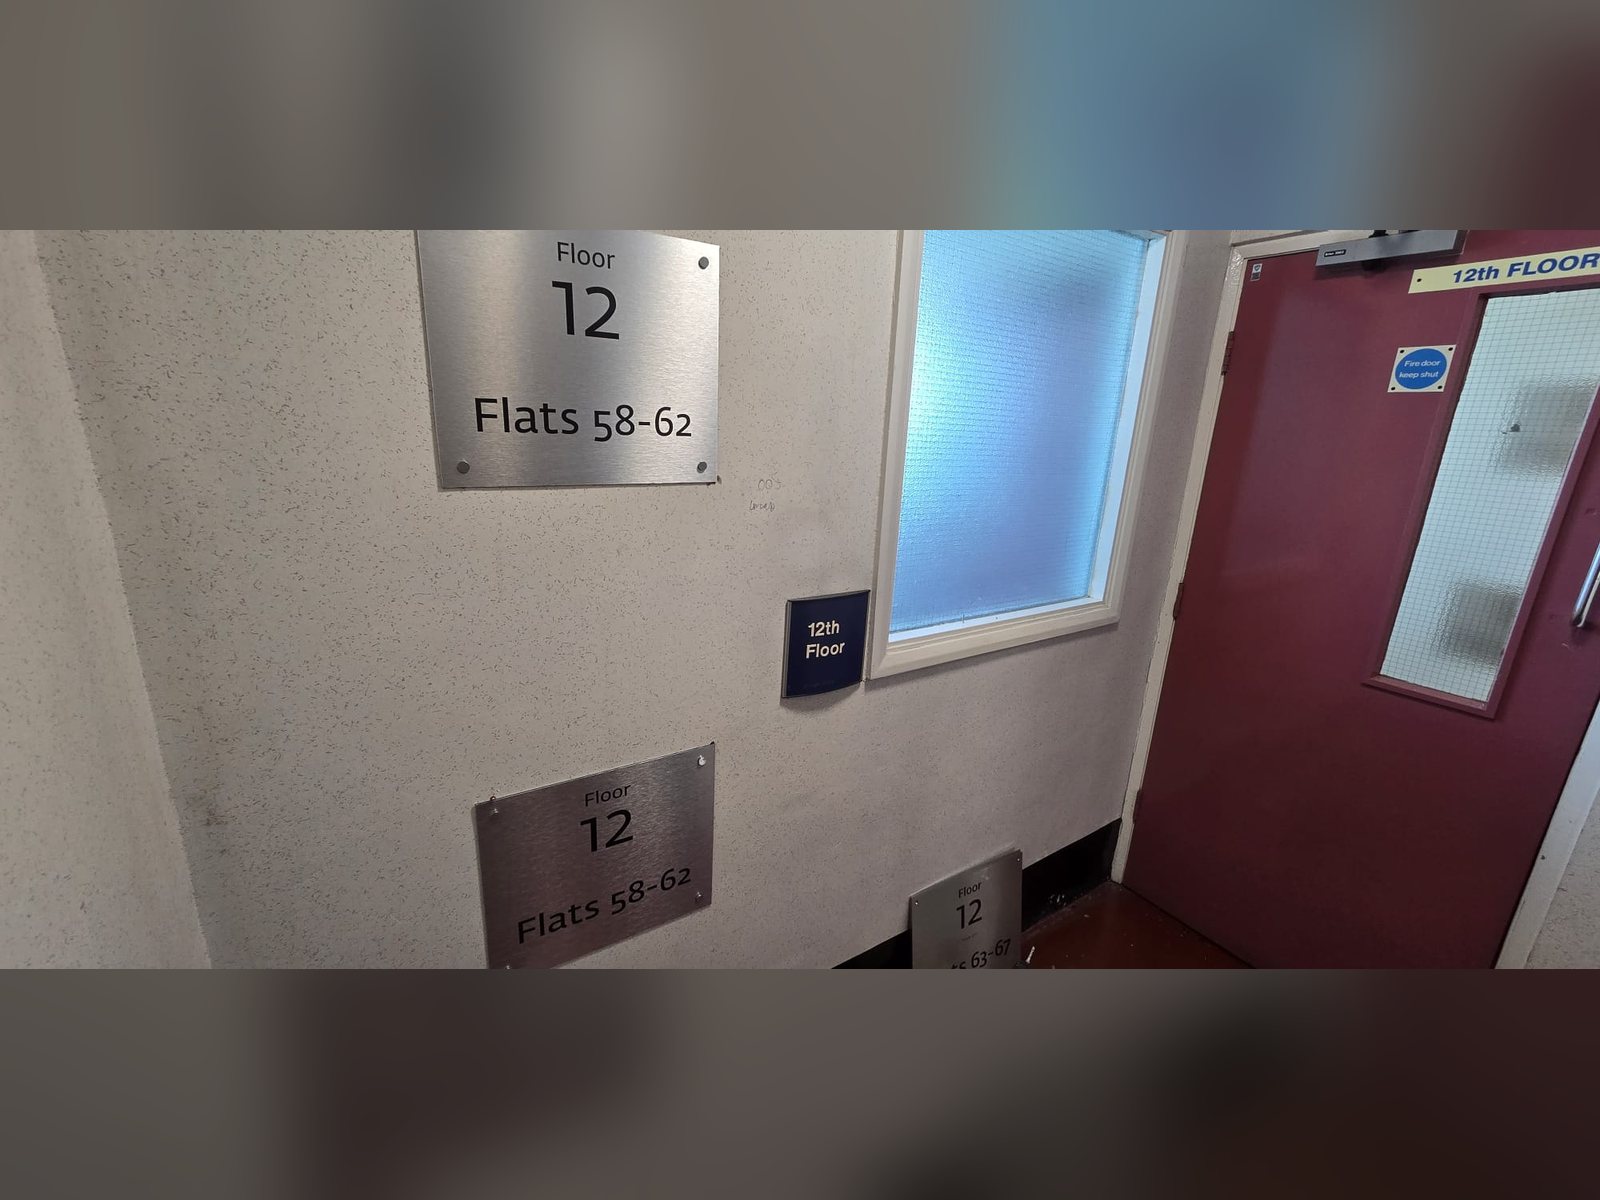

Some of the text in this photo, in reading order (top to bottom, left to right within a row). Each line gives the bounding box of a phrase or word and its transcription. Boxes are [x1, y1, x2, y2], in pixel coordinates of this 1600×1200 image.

[556, 241, 616, 269] Floor
[1453, 252, 1600, 284] 12th FLOOR
[551, 280, 620, 340] 12
[1399, 370, 1440, 379] keep shut
[1403, 359, 1441, 368] Fire door
[474, 397, 693, 442] Flats 58-62
[807, 620, 841, 638] 12th
[806, 642, 846, 659] Floor
[584, 784, 632, 807] Floor
[579, 808, 634, 853] 12
[957, 882, 983, 898] Floor
[516, 867, 692, 945] Flats 58-62
[955, 898, 983, 930] 12
[970, 938, 1012, 969] 63-67
